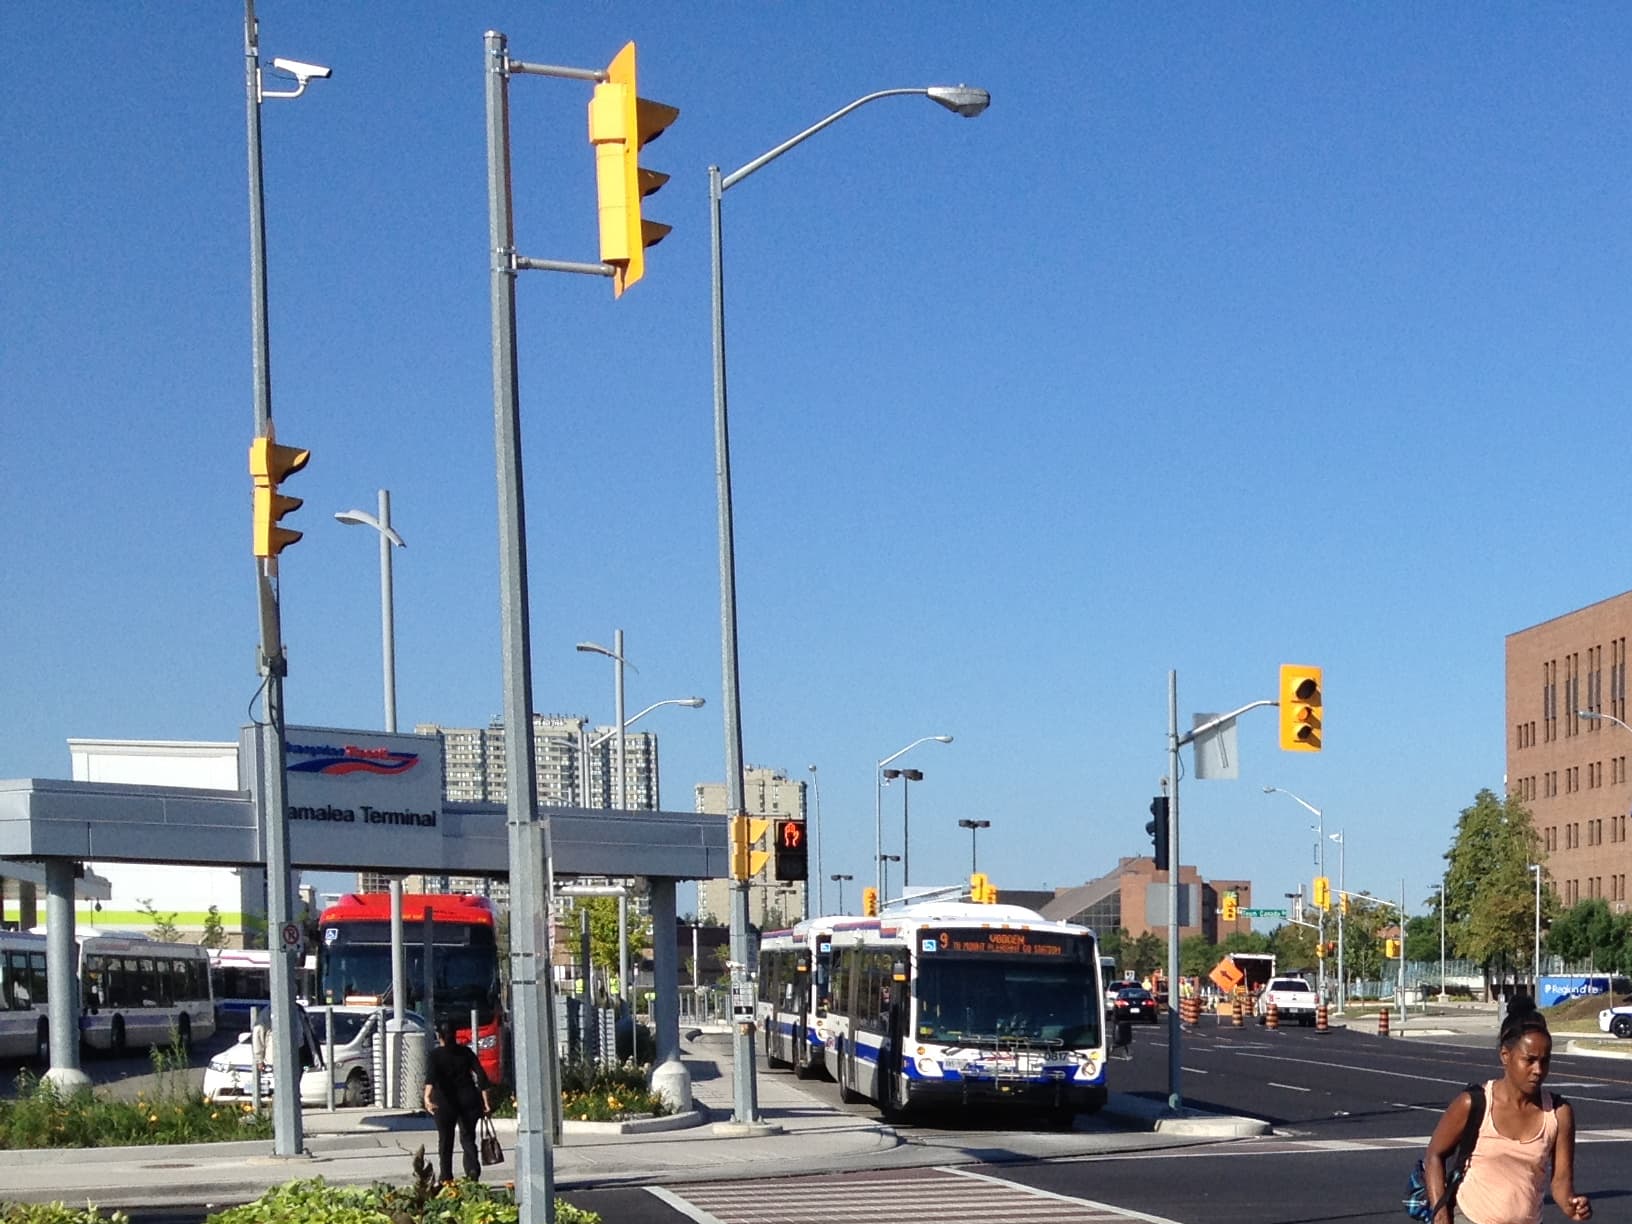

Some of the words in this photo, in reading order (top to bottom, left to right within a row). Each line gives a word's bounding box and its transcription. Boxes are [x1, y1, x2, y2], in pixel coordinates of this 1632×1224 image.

[287, 804, 355, 822] amalea
[360, 805, 437, 828] Terminal
[940, 932, 949, 949] 9
